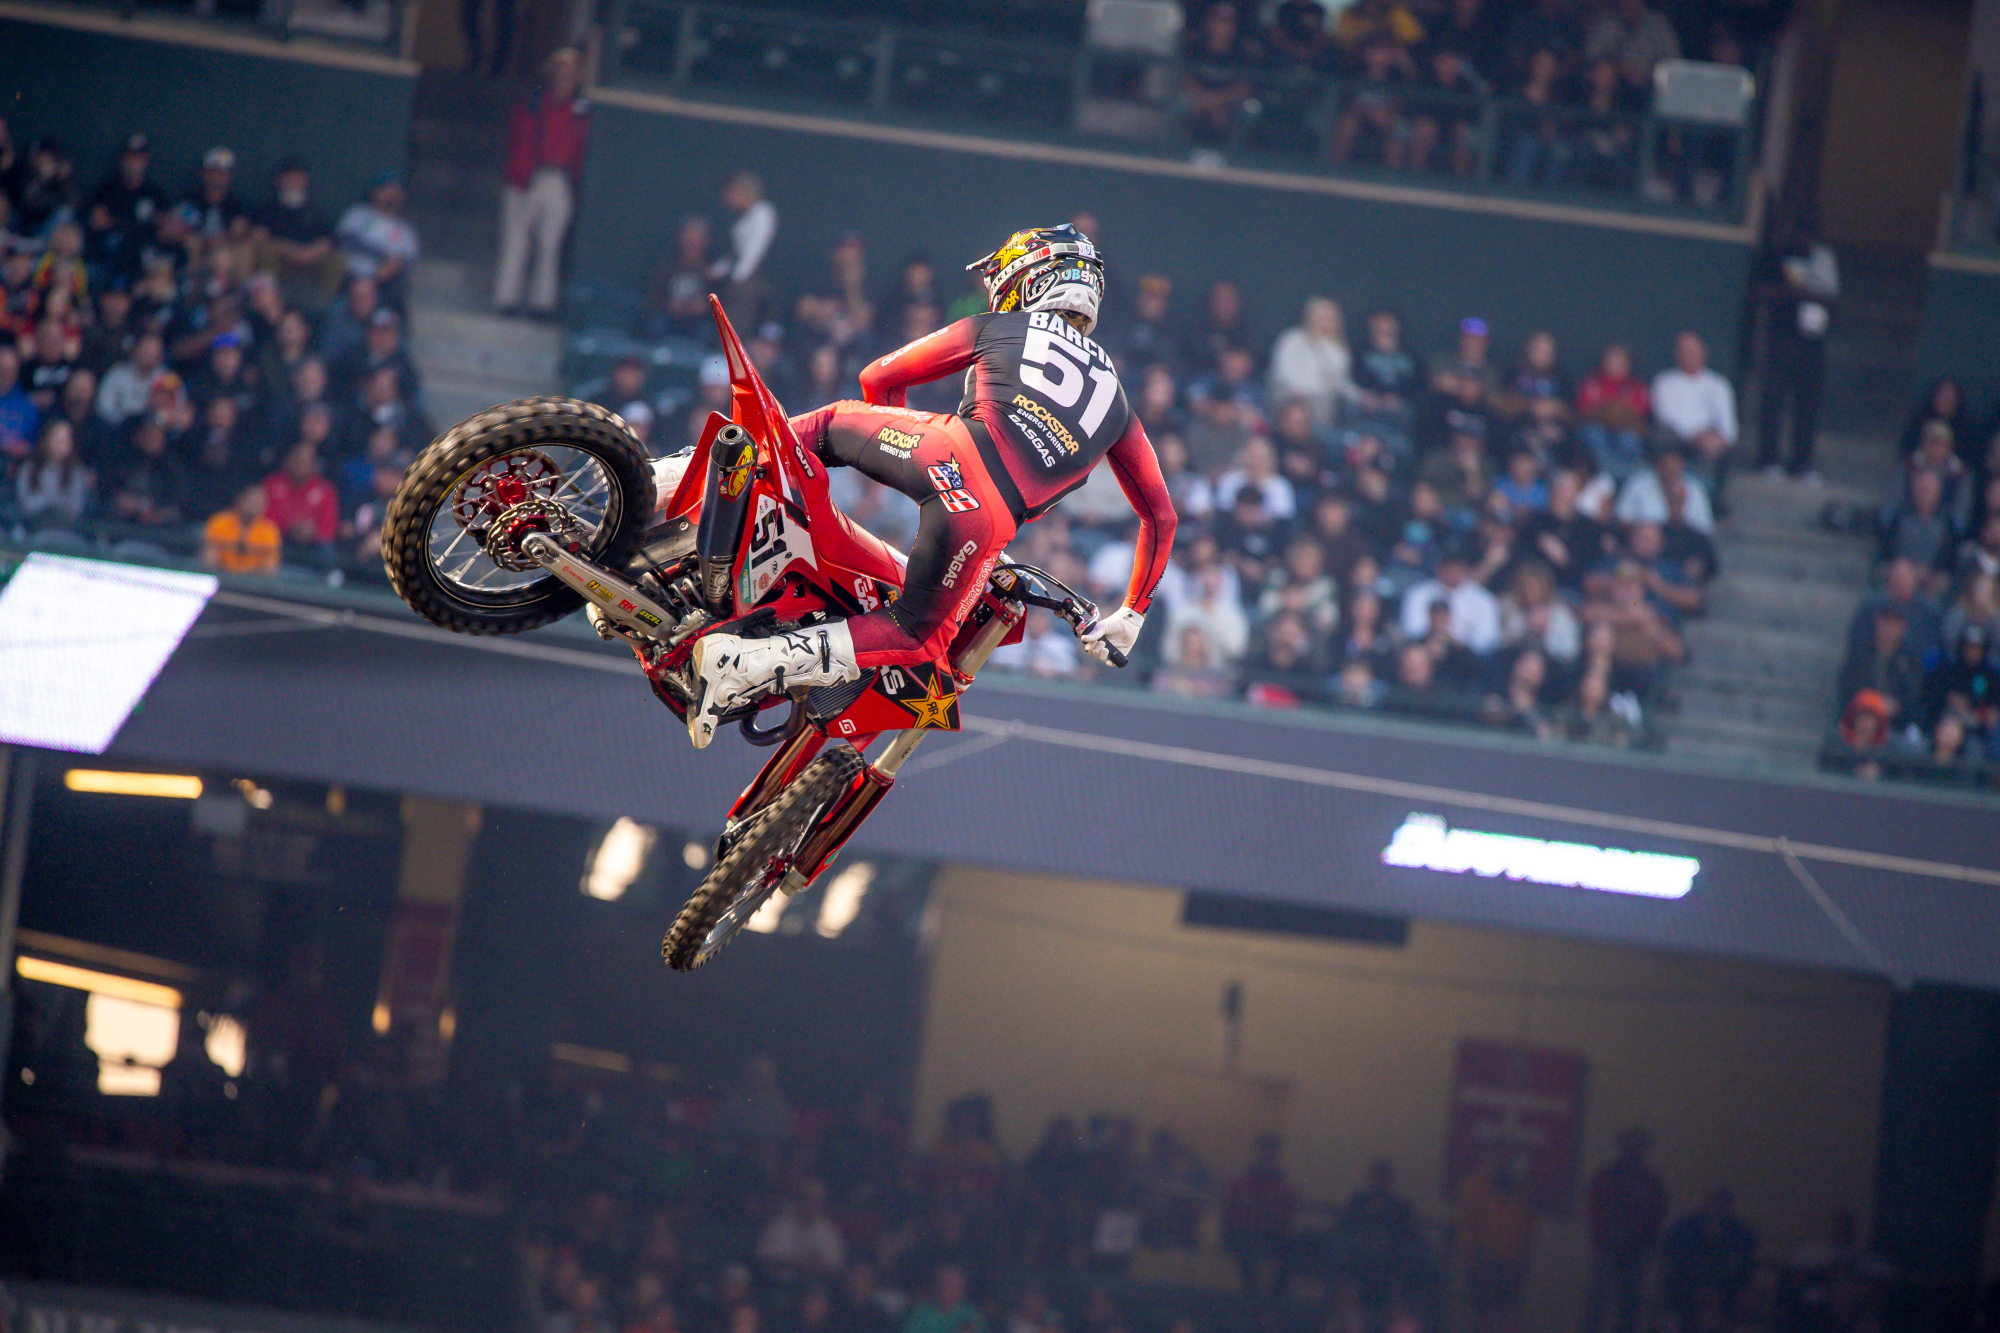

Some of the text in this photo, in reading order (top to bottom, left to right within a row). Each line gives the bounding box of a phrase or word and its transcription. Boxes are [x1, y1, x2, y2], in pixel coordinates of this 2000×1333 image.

[881, 327, 949, 367] GASGAS
[1019, 327, 1118, 439] 51
[1008, 414, 1056, 468] GASGAS
[1012, 394, 1080, 456] ROCKSTAR
[1016, 408, 1067, 457] ENERGY DRINK
[568, 569, 585, 583] brembo
[941, 540, 978, 589] GAGAS
[618, 599, 638, 613] RK
[639, 610, 662, 625] EXCEL
